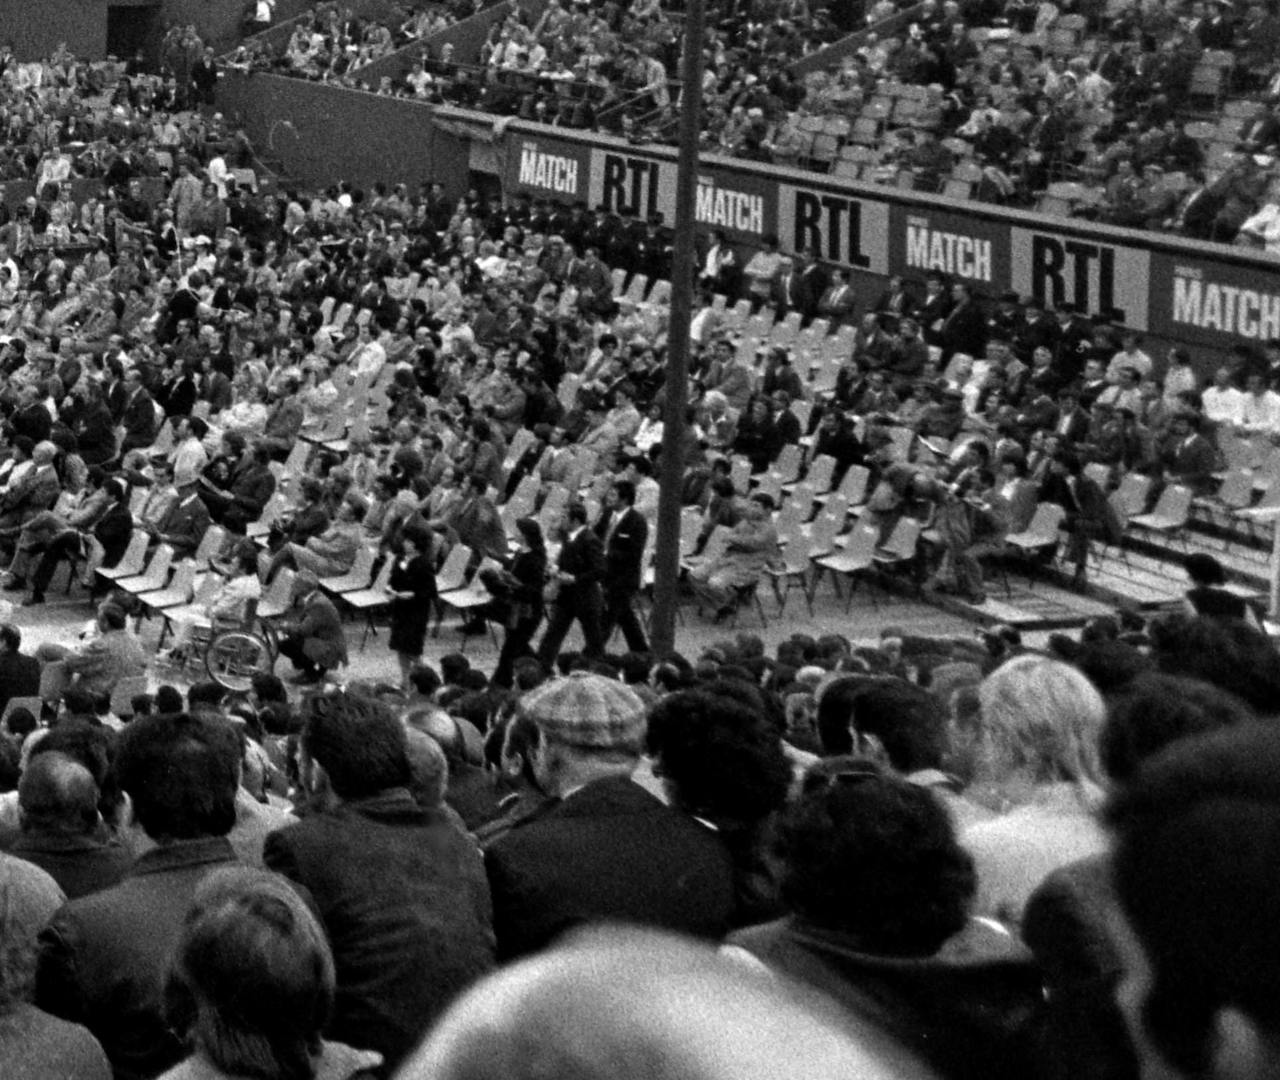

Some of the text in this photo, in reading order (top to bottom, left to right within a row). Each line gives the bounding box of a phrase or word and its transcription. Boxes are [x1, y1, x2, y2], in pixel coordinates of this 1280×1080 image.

[519, 149, 578, 194] MATCH
[603, 153, 665, 225] RTL
[696, 184, 763, 234] MATCH
[795, 191, 871, 268] RTL
[907, 226, 991, 281] MATCH
[1032, 234, 1126, 322] RTL
[1173, 278, 1280, 340] MATCH
